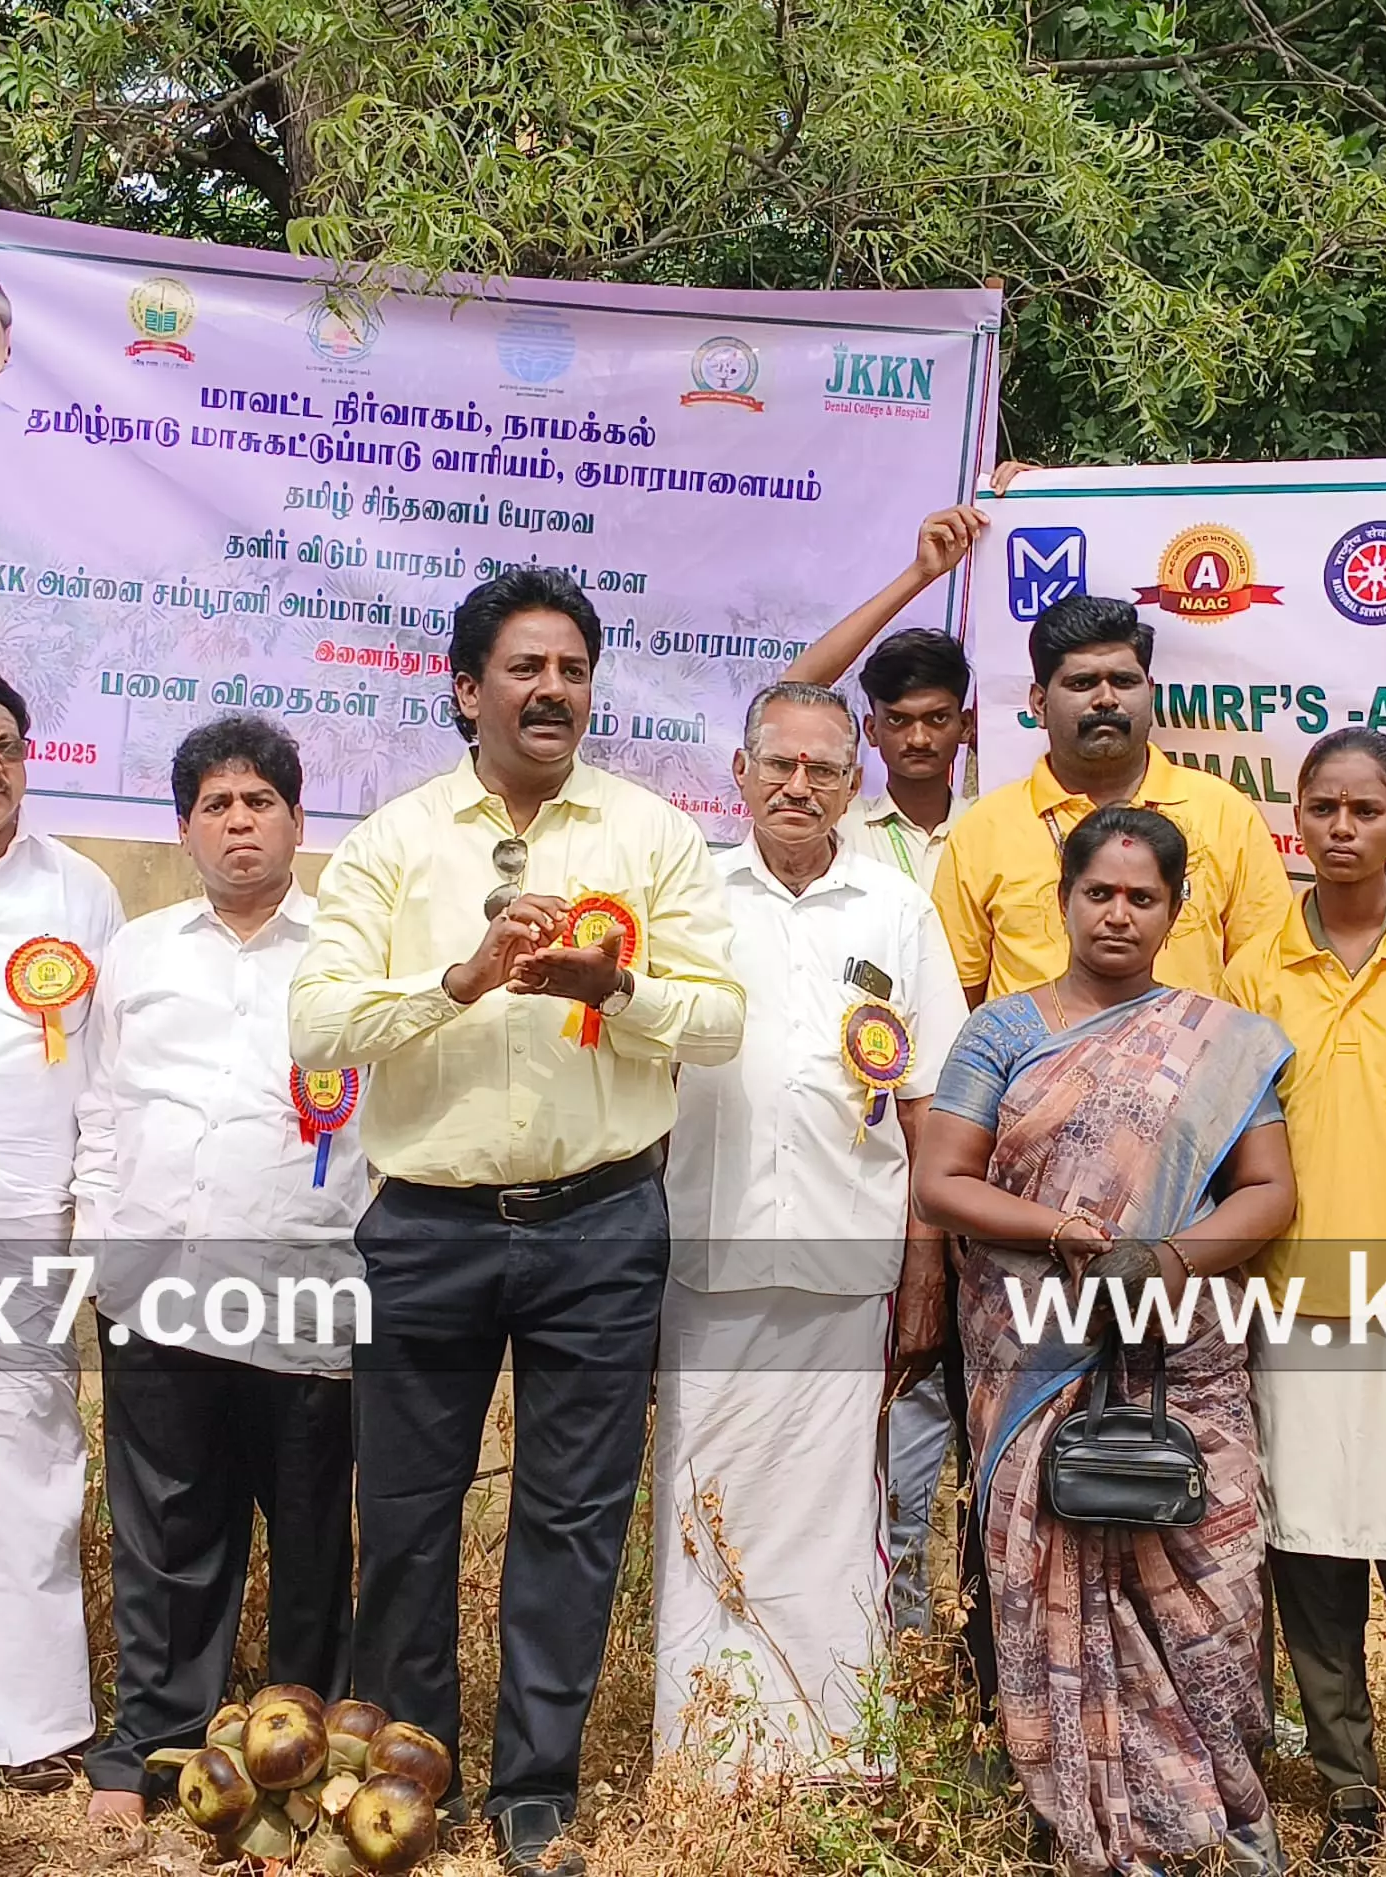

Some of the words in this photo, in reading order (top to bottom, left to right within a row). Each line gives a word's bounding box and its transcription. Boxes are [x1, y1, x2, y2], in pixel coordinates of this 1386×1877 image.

[825, 352, 935, 401] JKKN
[201, 386, 323, 419] மாவட்ட
[334, 391, 493, 438] நிர்வாகம்,
[502, 411, 657, 448] நாமக்கல்
[825, 401, 852, 414] Dental
[854, 403, 884, 418] College
[886, 406, 892, 416] &
[894, 406, 930, 421] Hospital
[24, 403, 180, 447] தமிழ்நாடு
[191, 422, 421, 472] மாசுகட்டுப்பாடு
[433, 444, 564, 483] வாரியம்,
[575, 461, 822, 501] குமாரபாளையம்
[284, 481, 354, 520] தமிழ்
[362, 485, 490, 527] சிந்தனைப்
[498, 501, 595, 535] பேரவை
[224, 529, 289, 561] தளிர்
[297, 534, 368, 569] விடும்
[376, 547, 466, 581] பாரதம்
[1012, 536, 1082, 579] M
[1168, 534, 1209, 576] ACCREDITED
[1210, 535, 1231, 547] WITH
[1230, 543, 1247, 574] GRADE
[1191, 555, 1221, 589] A
[37, 567, 143, 604] அன்னை
[152, 576, 270, 618] சம்பூரணி
[279, 588, 393, 626] அம்மாள்
[1179, 595, 1230, 611] NAAC
[1332, 578, 1359, 613] NATIONAL
[315, 640, 421, 676] இணைந்து
[101, 670, 199, 703] பனை
[213, 673, 380, 718] விதைகள்
[631, 711, 706, 744] பணி
[27, 739, 97, 764] 1.2025
